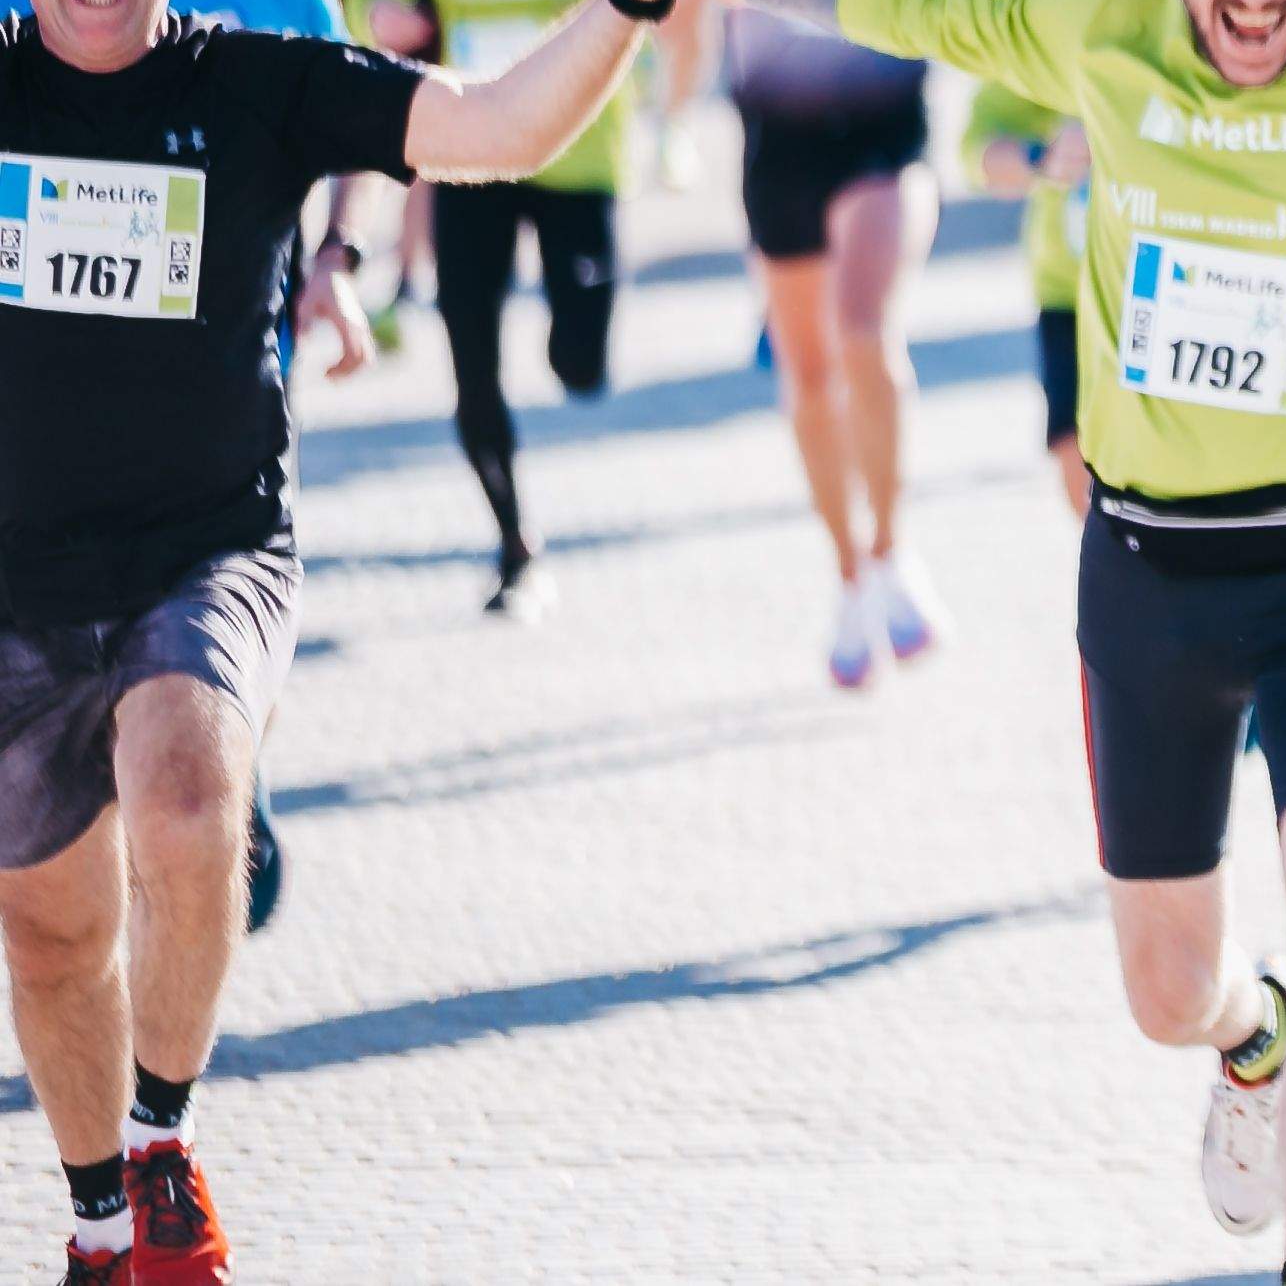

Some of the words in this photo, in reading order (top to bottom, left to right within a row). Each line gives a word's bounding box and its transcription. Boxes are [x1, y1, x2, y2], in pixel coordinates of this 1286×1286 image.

[76, 182, 158, 205] MetLife
[1109, 181, 1158, 227] VIII
[46, 253, 142, 302] 1767
[1206, 270, 1286, 296] MetLife
[1170, 339, 1265, 393] 1792
